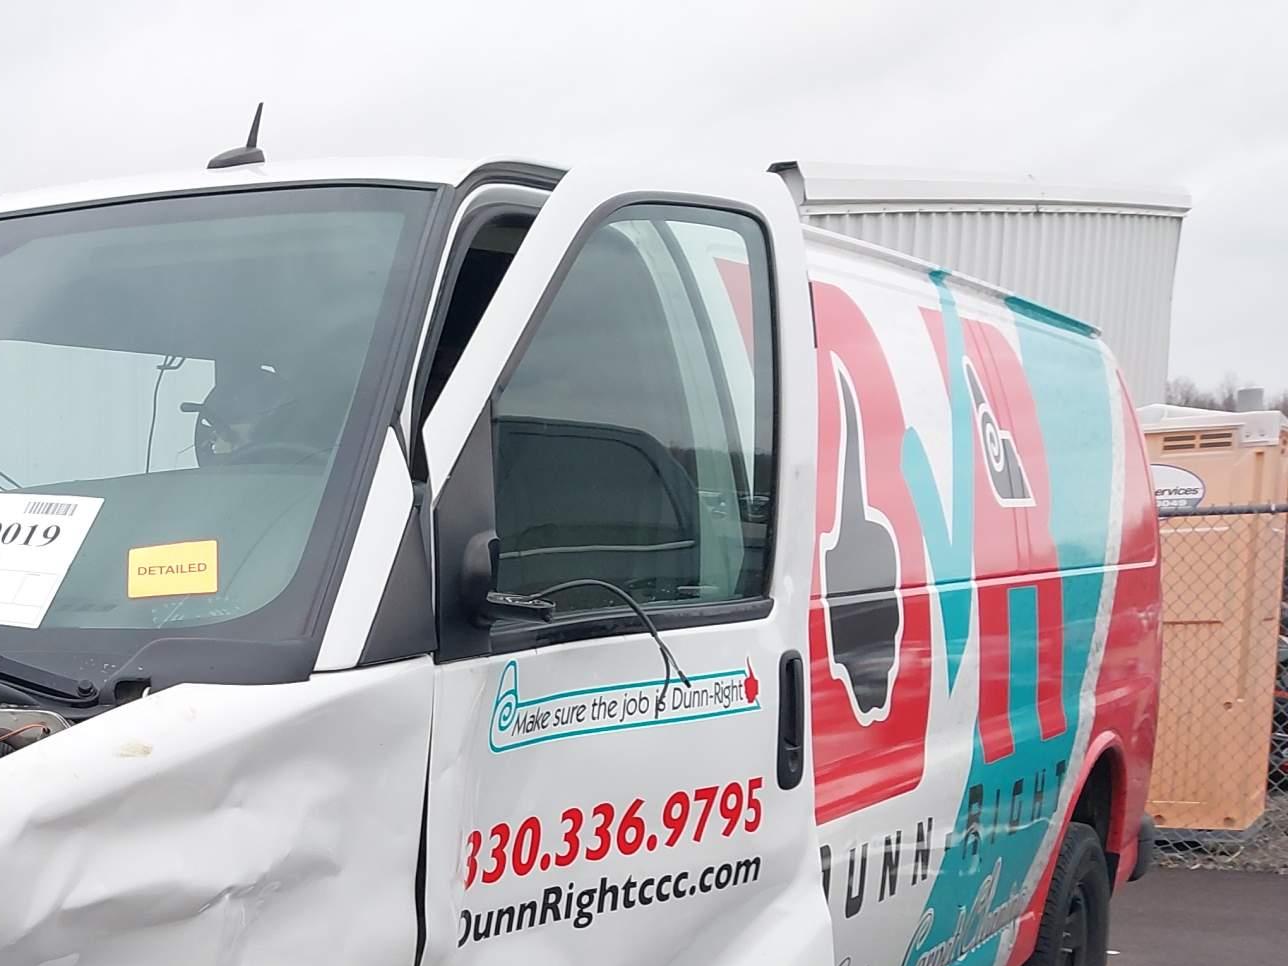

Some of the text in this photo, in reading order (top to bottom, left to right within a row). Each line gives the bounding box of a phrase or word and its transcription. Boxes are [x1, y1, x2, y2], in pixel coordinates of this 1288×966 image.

[1154, 486, 1199, 496] ervices
[137, 562, 208, 576] DETAILED
[511, 709, 550, 736] Make
[554, 703, 587, 725] sure
[591, 695, 617, 721] the
[619, 691, 649, 723] job
[671, 680, 743, 711] Dunn-Right
[463, 777, 762, 891] 330.336.9795
[458, 856, 761, 948] DunnRightccc.com
